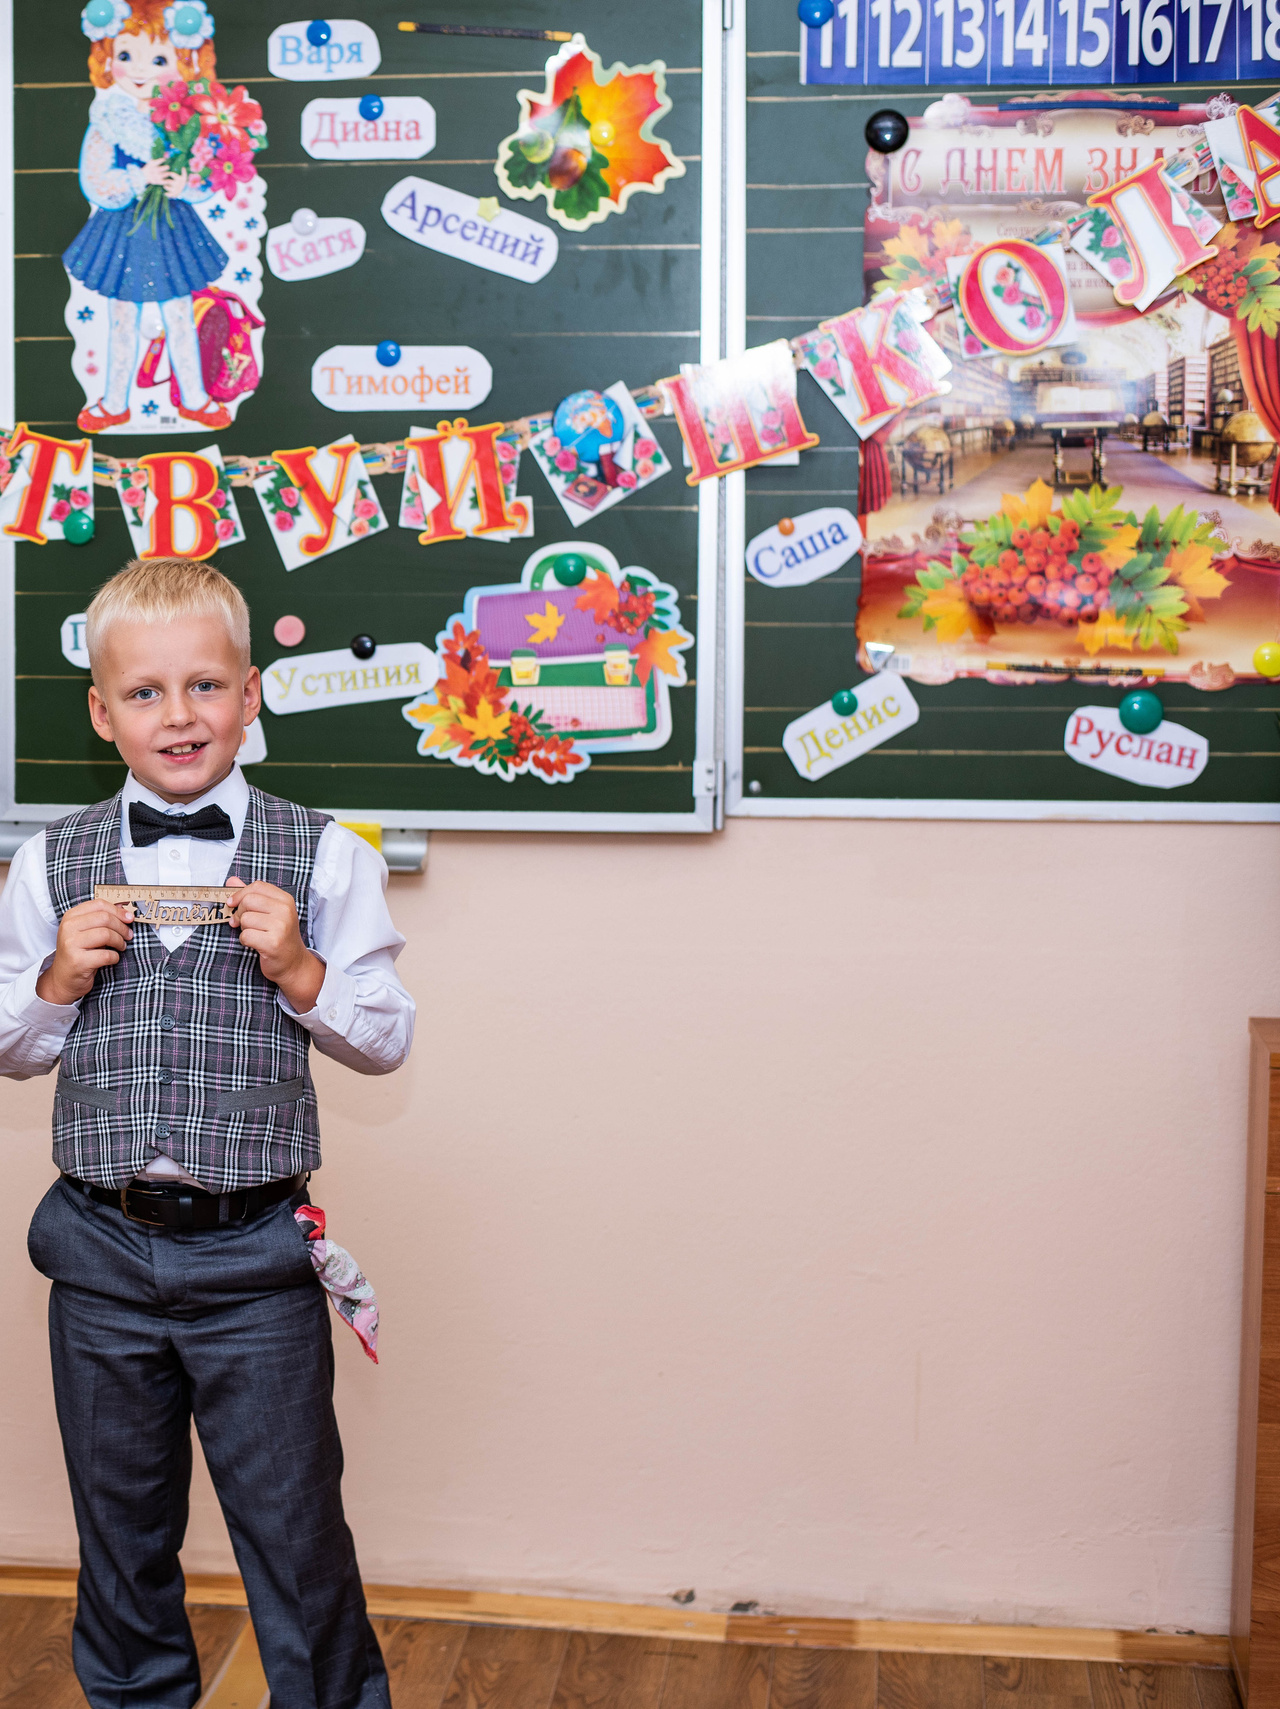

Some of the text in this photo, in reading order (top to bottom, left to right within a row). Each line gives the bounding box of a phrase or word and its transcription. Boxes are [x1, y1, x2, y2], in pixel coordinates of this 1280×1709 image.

[277, 35, 364, 73] Варя
[871, 0, 922, 68] 12
[934, 0, 985, 68] 13
[995, 0, 1048, 67] 14
[1059, 0, 1110, 67] 15
[1121, 0, 1172, 66] 16
[1181, 0, 1232, 64] 17
[310, 111, 422, 148] Диана
[898, 147, 922, 194] С
[939, 146, 1067, 195] ДНЕМ
[272, 228, 358, 273] Катя
[391, 190, 545, 266] Арсений
[320, 365, 472, 403] Тимофей
[754, 521, 849, 579] Саша
[271, 662, 422, 699] Устиния
[796, 695, 901, 773] Денис
[1069, 713, 1199, 770] Руслан
[140, 899, 218, 930] Артём
